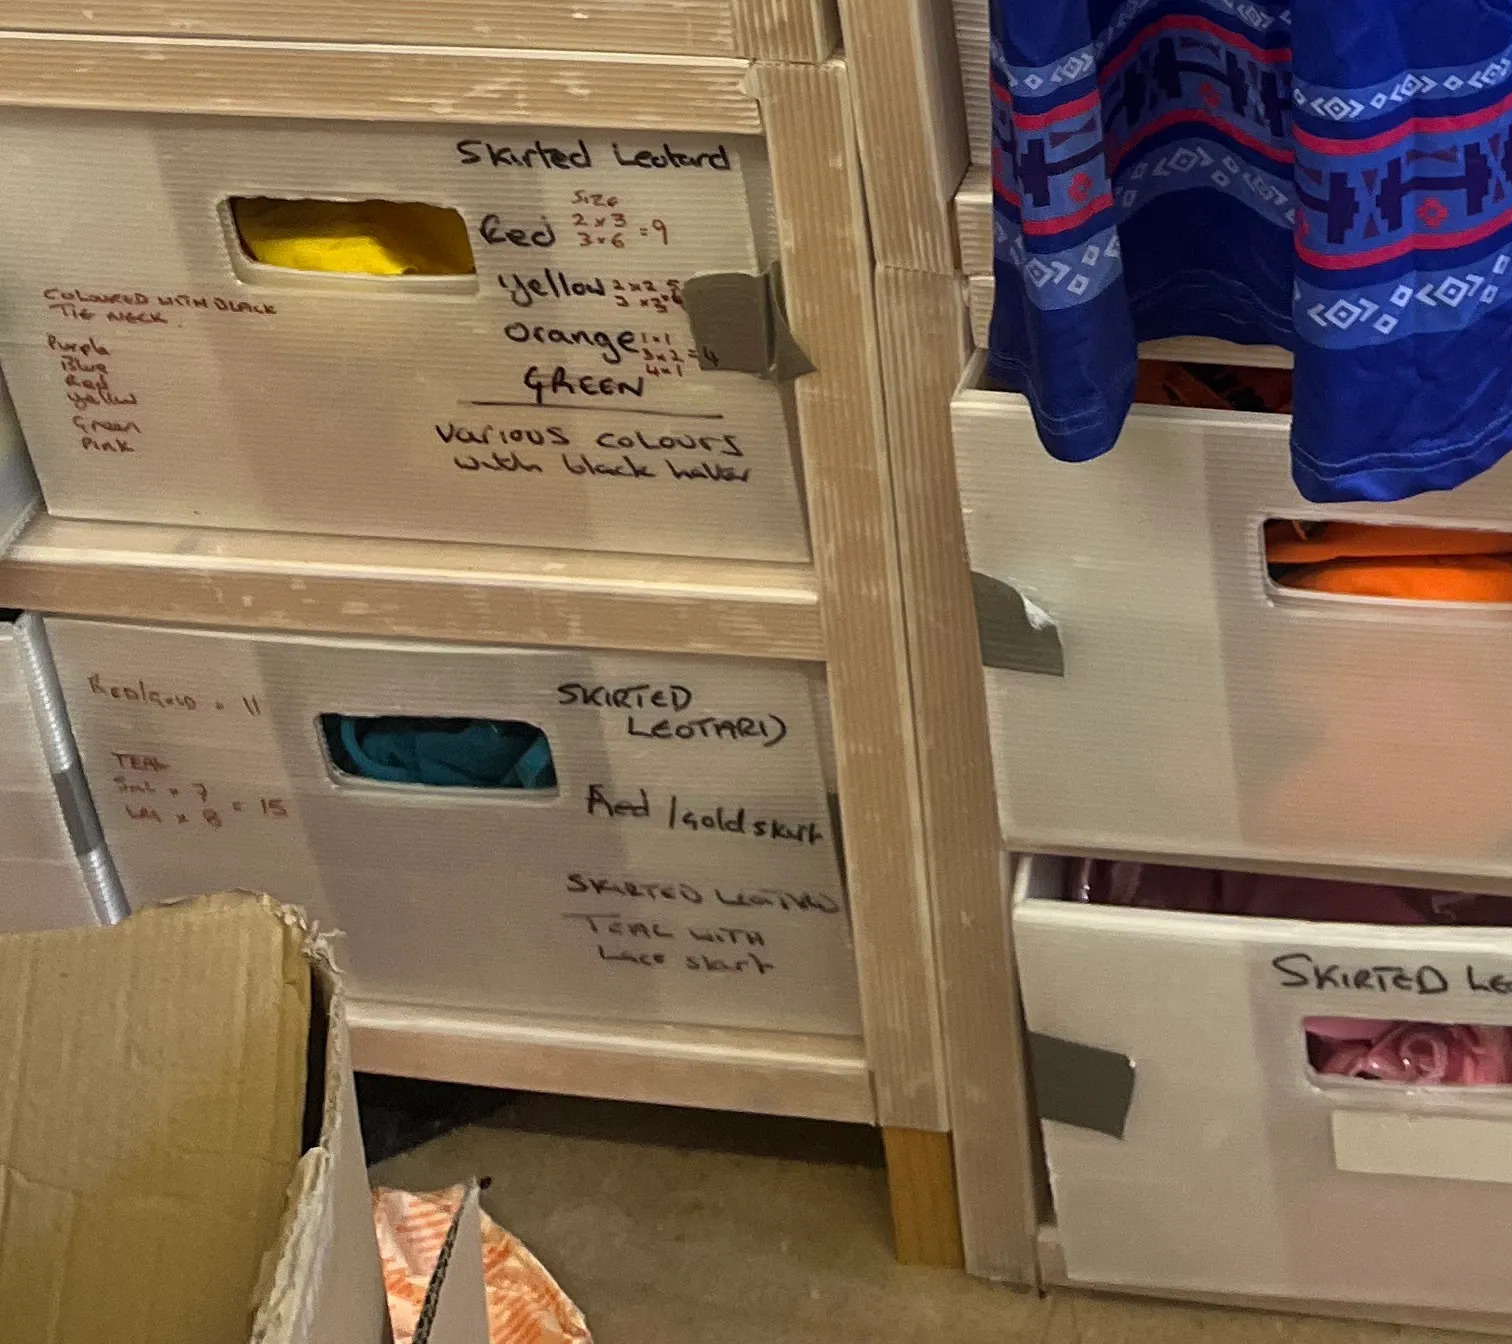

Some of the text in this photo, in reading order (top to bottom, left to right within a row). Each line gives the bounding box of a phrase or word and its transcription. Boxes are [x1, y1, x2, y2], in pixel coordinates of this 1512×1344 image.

[456, 139, 731, 171] Skirted Leotard
[480, 214, 557, 247] Red
[578, 232, 594, 248] 3
[612, 232, 626, 248] 6
[651, 219, 669, 246] 9
[43, 288, 149, 305] COLOURED
[504, 321, 640, 363] Orange
[524, 365, 644, 404] GREEN
[557, 683, 693, 712] SKIRTED
[628, 714, 788, 748] LEOTARD
[260, 797, 289, 817] 15
[585, 783, 650, 817] Red
[567, 873, 704, 904] SKIRTED
[1273, 953, 1449, 996] SKIRTED
